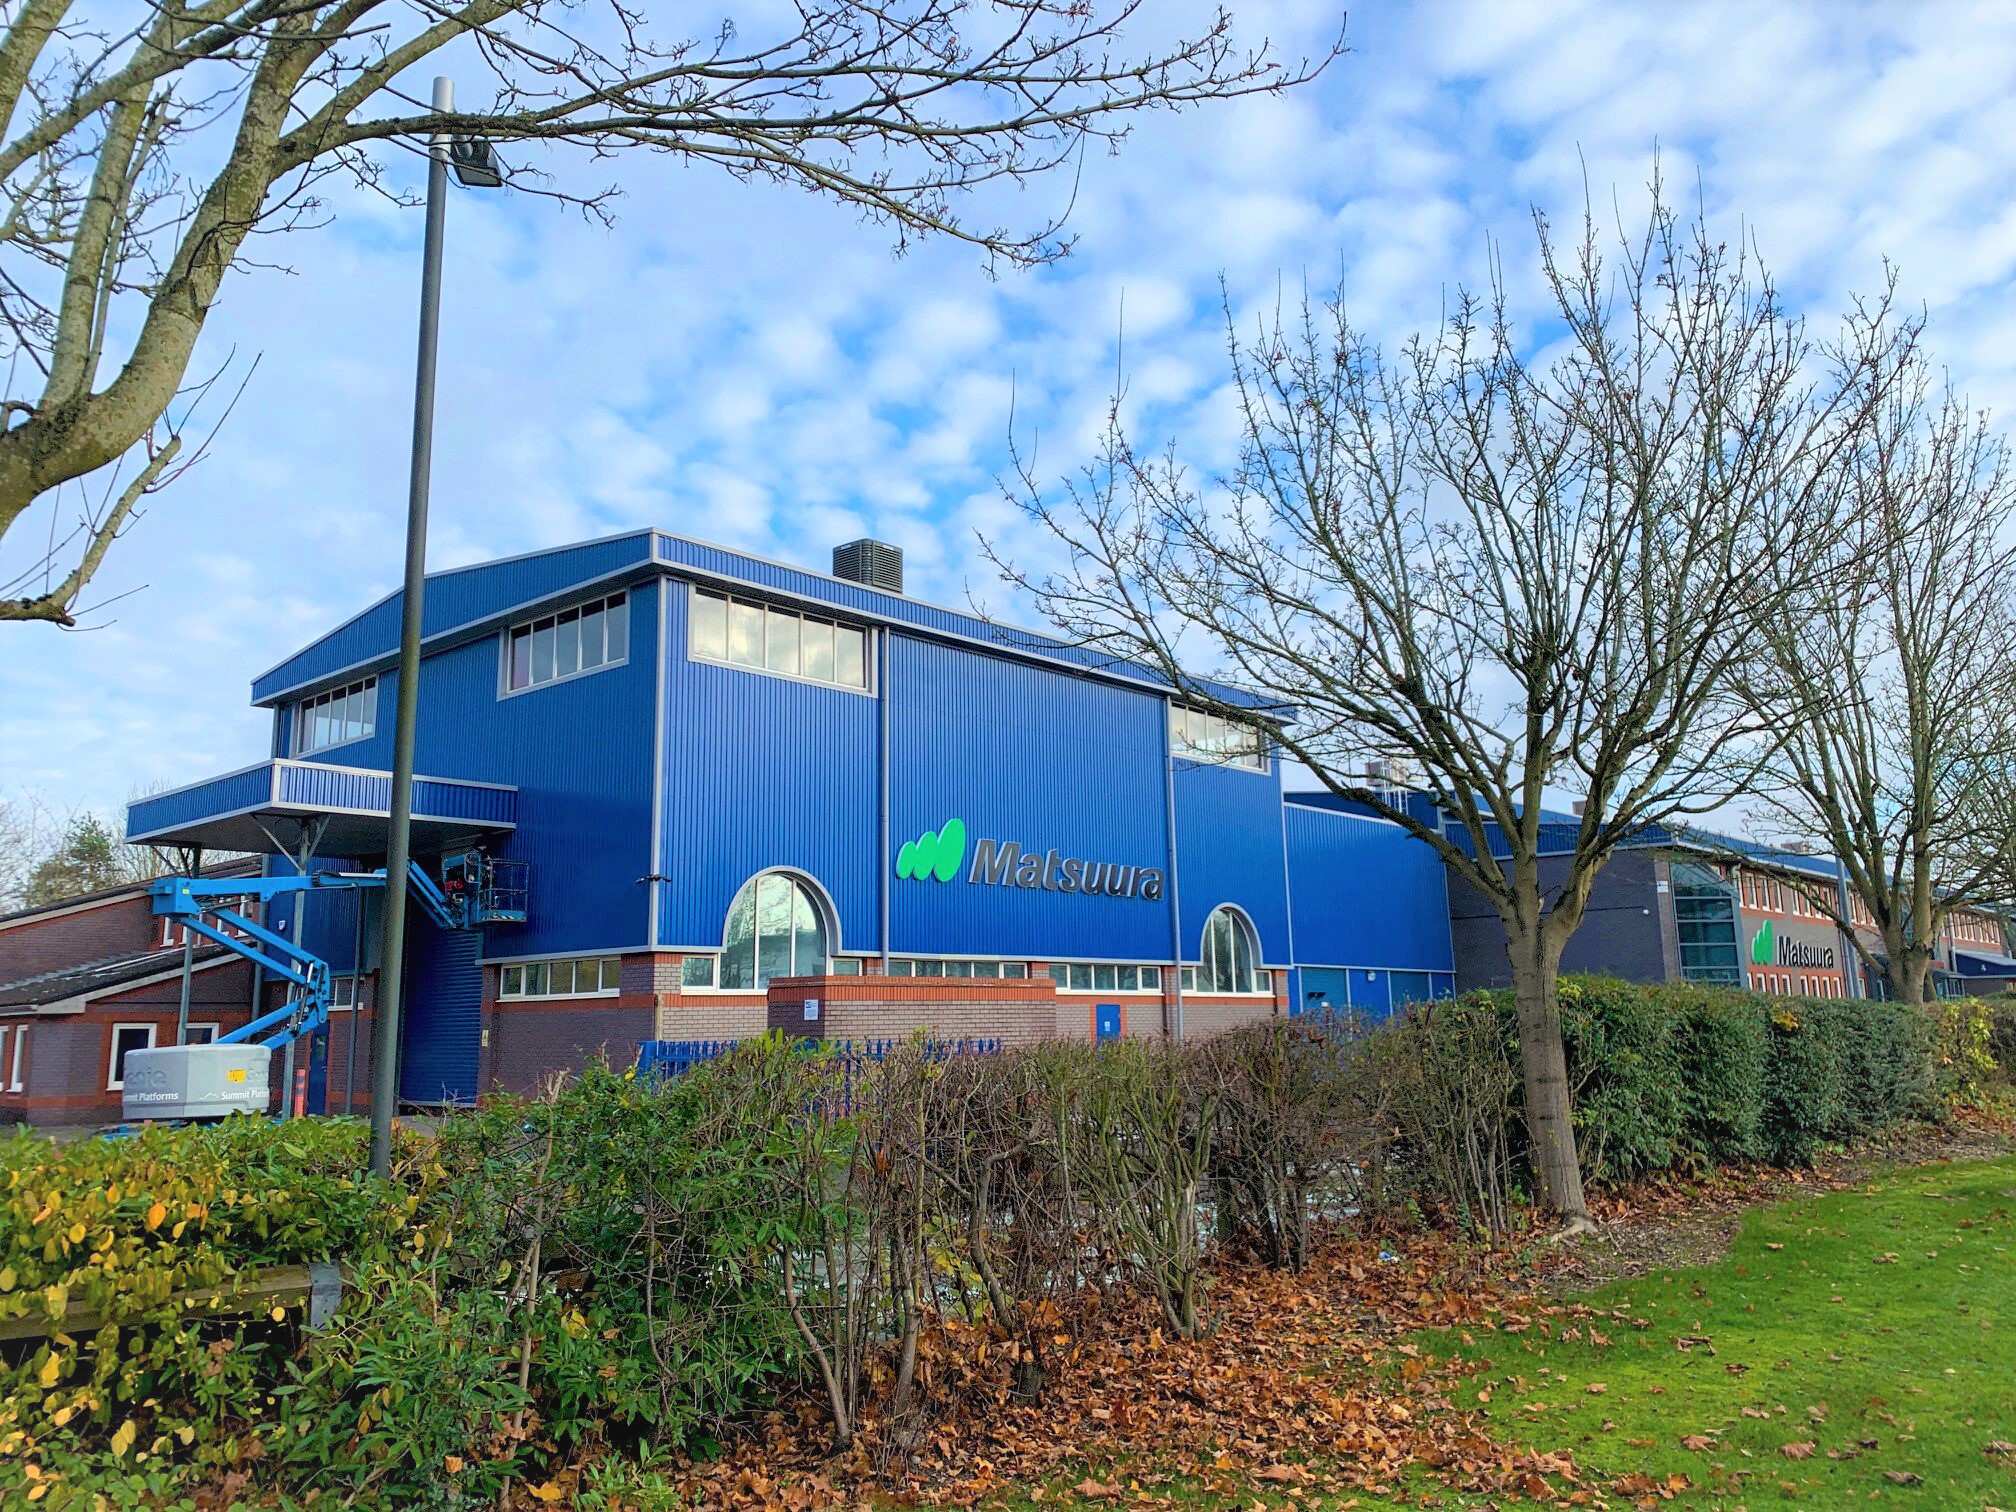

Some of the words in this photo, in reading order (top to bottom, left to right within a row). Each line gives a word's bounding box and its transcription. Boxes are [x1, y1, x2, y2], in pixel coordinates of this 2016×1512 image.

[969, 838, 1164, 899] Matsuura
[1776, 935, 1834, 968] Matsuura
[139, 1092, 179, 1101] Platforms
[221, 1091, 250, 1100] Summit
